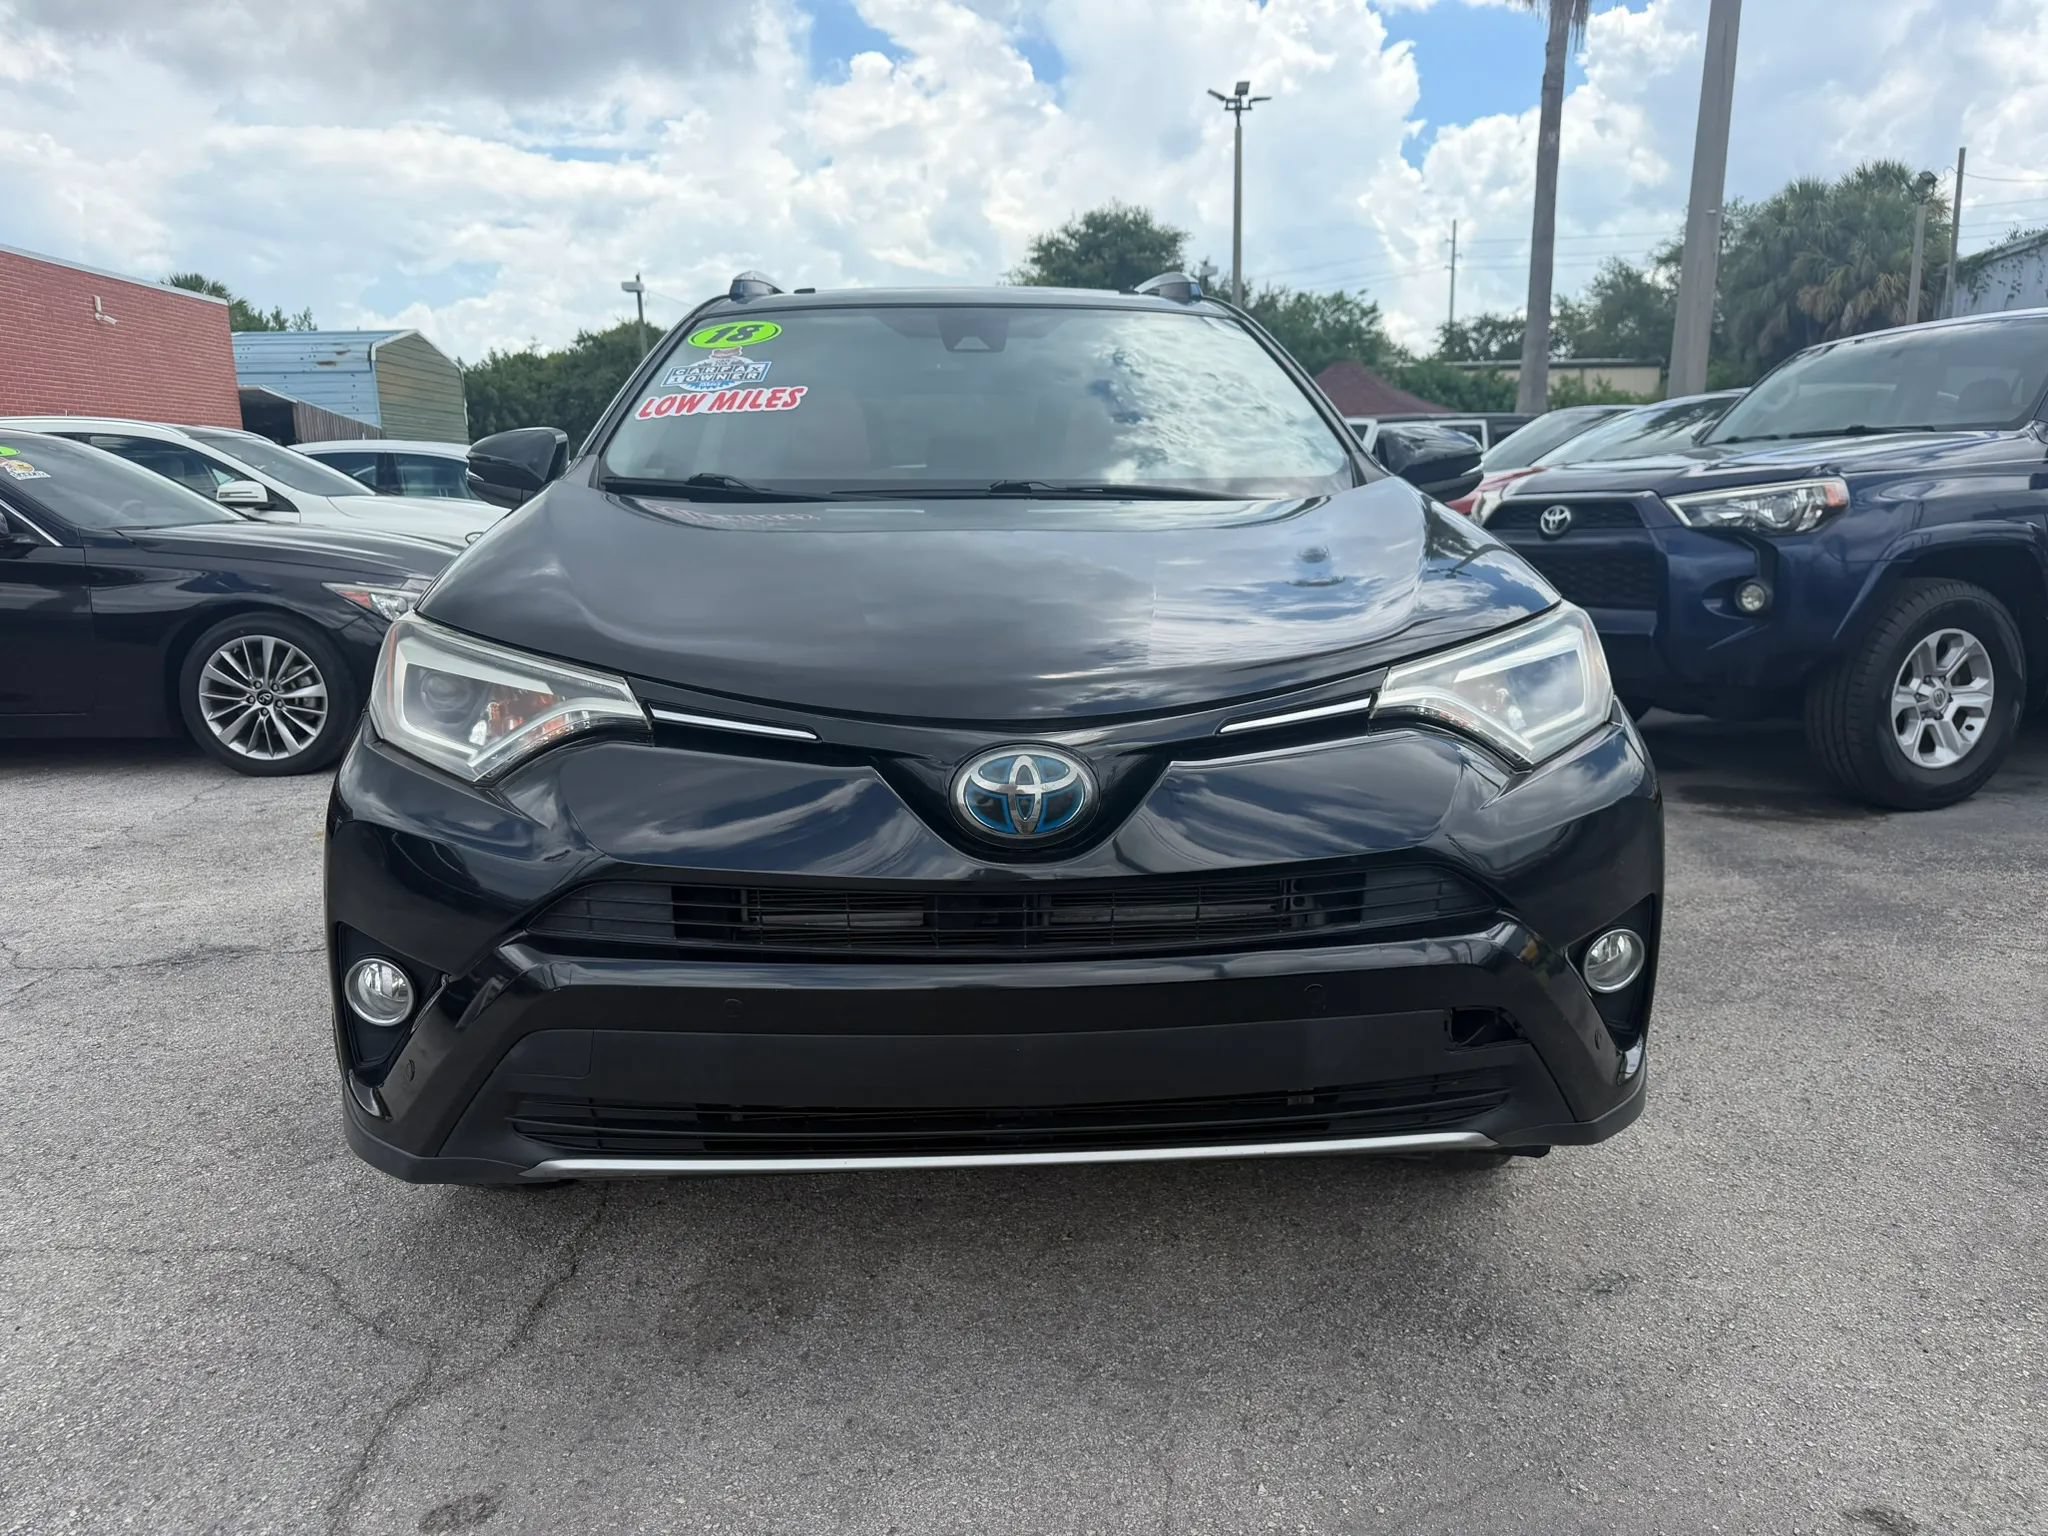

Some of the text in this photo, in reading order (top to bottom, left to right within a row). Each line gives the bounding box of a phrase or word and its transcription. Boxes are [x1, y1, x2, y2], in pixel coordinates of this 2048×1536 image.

[705, 324, 765, 343] 18
[675, 365, 762, 376] CARFAX
[639, 387, 805, 418] LOW MILES
